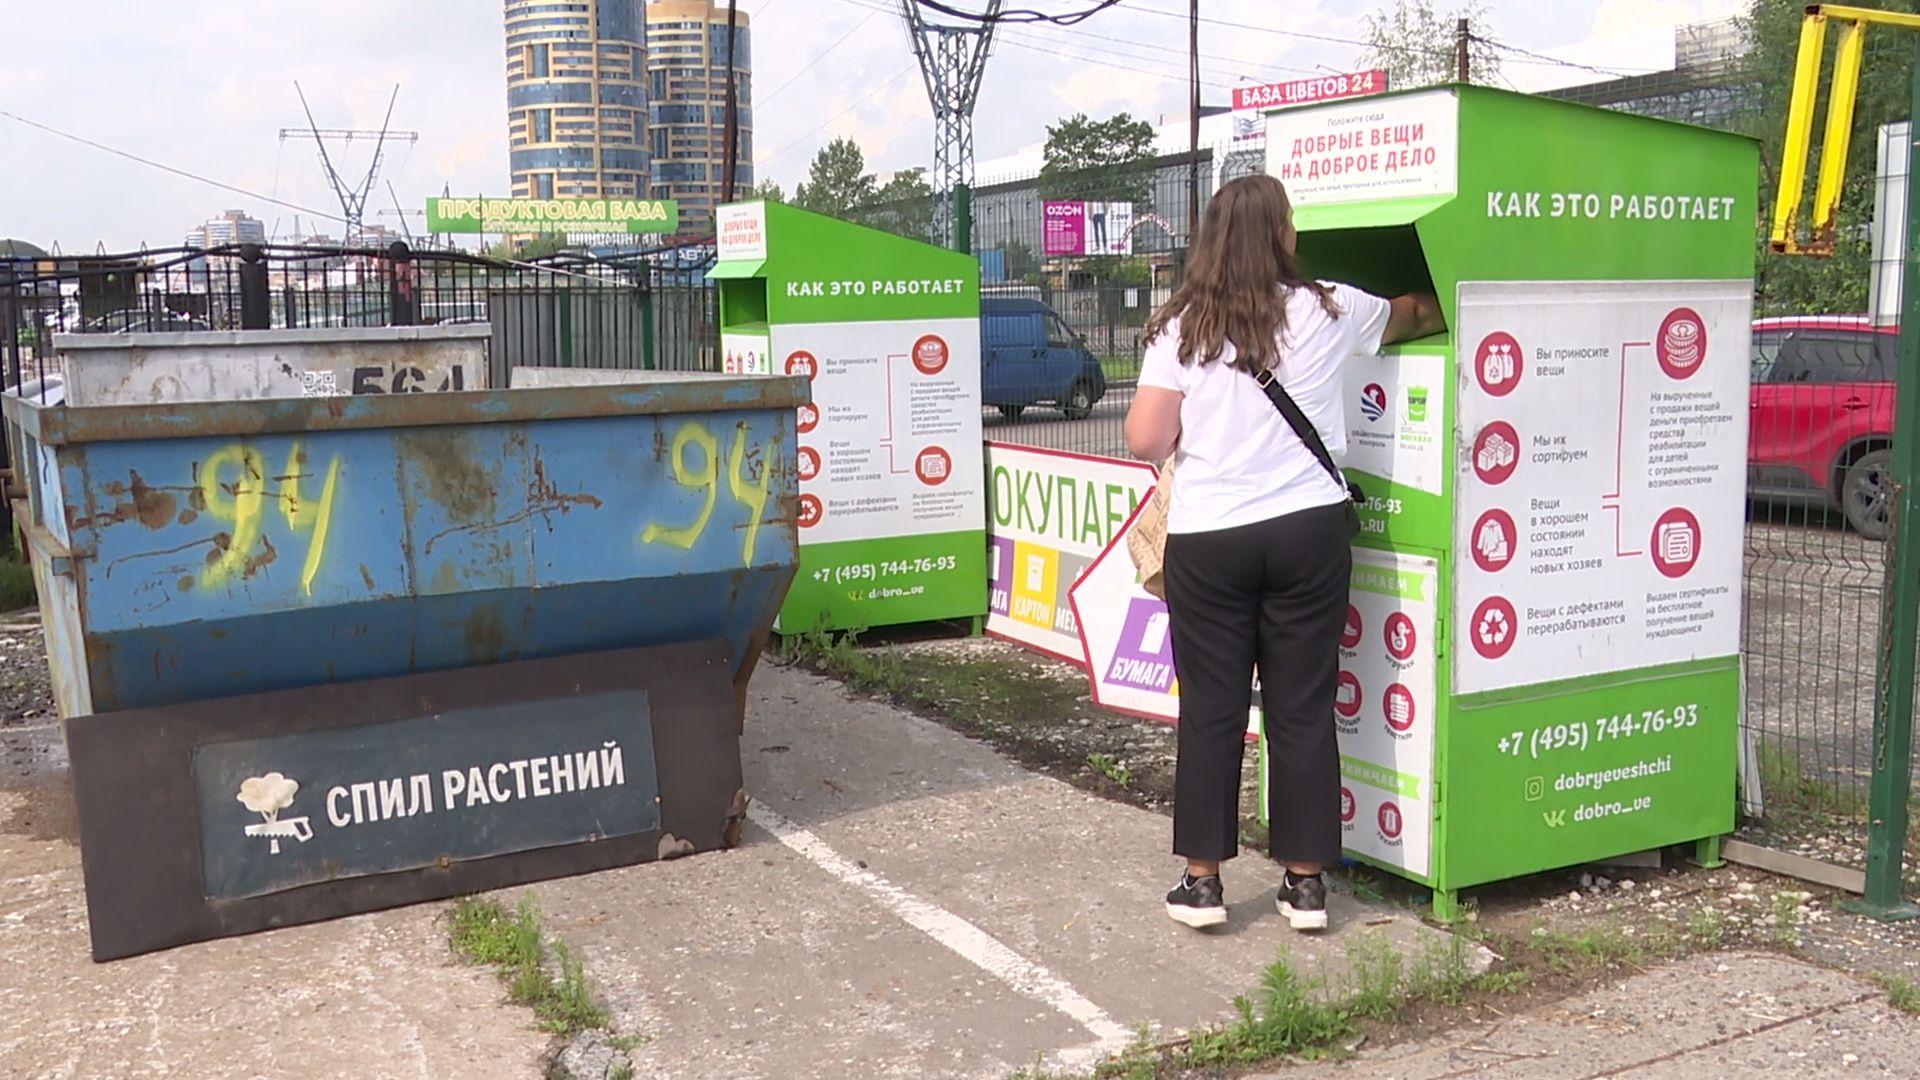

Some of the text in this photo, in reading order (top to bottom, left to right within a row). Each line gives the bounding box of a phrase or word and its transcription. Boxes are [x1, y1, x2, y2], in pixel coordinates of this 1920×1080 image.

[1242, 75, 1374, 106] БАЗА ЦВЕТОВ 24
[1328, 112, 1385, 127] Положите сюда
[1292, 123, 1424, 158] ДОБРЫЕ ВЕЩИ
[1282, 147, 1436, 180] НА ДОБРОЕ ДЕЛО
[438, 199, 667, 220] ПРОДУКТОВАЯ БАЗА
[1047, 205, 1082, 216] OZON
[1487, 192, 1735, 221] КАК ЭТО РАБОТАЕТ
[787, 279, 964, 297] КАК ЭТО РАБОТАЕТ
[1536, 347, 1610, 363] Вы приносите
[1536, 365, 1565, 377] вещи
[1650, 391, 1713, 404] На вырученные
[1650, 402, 1721, 417] с продажи вещей
[1650, 413, 1733, 428] деньги приобретаем
[1533, 435, 1567, 447] Мы их
[1649, 428, 1686, 440] средства
[1649, 438, 1707, 452] реабилитации
[1532, 449, 1588, 464] сортируем
[1648, 452, 1689, 465] для детей
[1648, 463, 1720, 477] с ограниченными
[1648, 475, 1713, 489] возможностями
[642, 418, 771, 569] 94
[993, 465, 1140, 547] ОКУПАЕ
[1530, 498, 1560, 513] Вещи
[201, 443, 342, 596] 94
[1530, 512, 1589, 527] в хорошем
[1530, 529, 1586, 542] состоянии
[1530, 545, 1574, 560] находят
[813, 555, 956, 585] +7 (495) 744-76-93
[1530, 558, 1603, 575] новых хозяев
[991, 588, 1007, 612] АГА
[1646, 584, 1729, 603] Выдаем сертификаты
[1013, 596, 1051, 625] КАРТОН
[1527, 599, 1624, 622] Вещи с дефектами
[1646, 600, 1703, 615] на бесплатное
[1056, 607, 1079, 634] МЕТ
[1526, 614, 1626, 637] перерабатываются
[1645, 609, 1715, 628] получение вещей
[1645, 624, 1703, 640] нуждающимся
[1109, 656, 1171, 689] БУМАГА
[1497, 703, 1698, 759] +7 (495) 744-76-93
[1554, 754, 1672, 791] dobryeveshchi
[325, 740, 625, 828] СПИЛ РАСТЕНИЙ
[1573, 795, 1652, 823] dobro_ve
